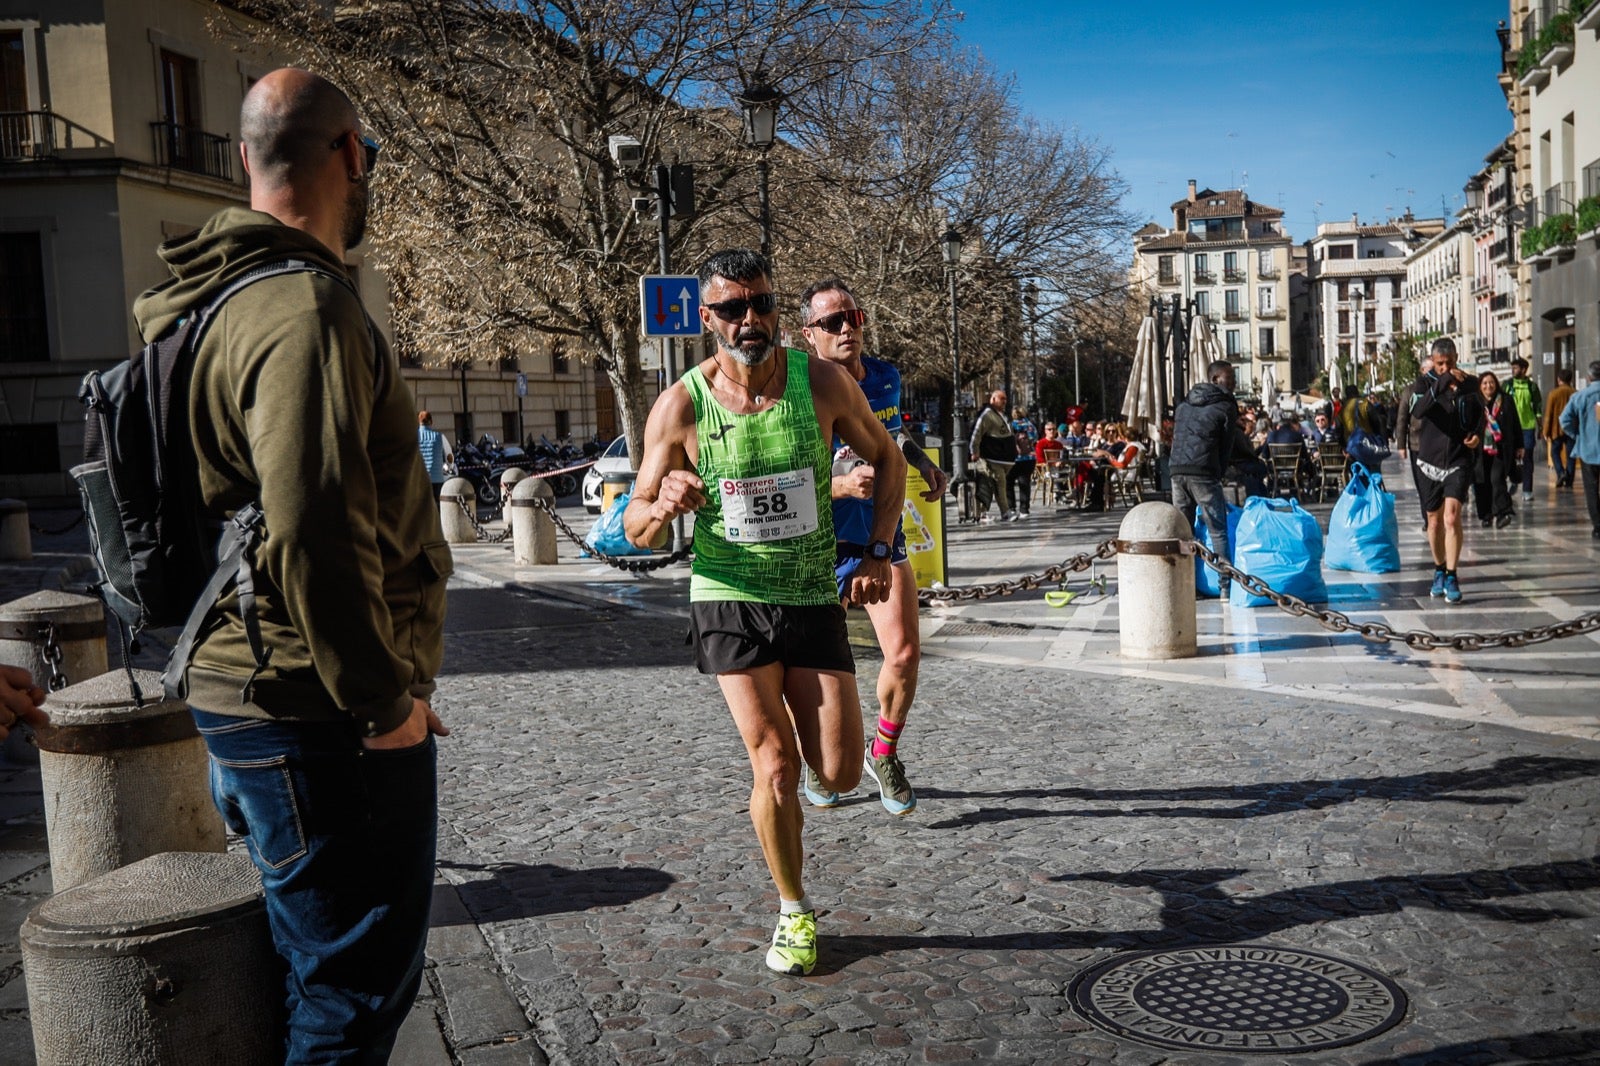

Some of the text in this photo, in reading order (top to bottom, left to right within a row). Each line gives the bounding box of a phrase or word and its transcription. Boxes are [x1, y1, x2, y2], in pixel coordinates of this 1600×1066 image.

[875, 405, 899, 421] mpo
[723, 479, 774, 495] 9 Carrera
[736, 485, 778, 496] Solidaria
[753, 493, 788, 515] 58
[744, 516, 764, 525] FRAN
[1129, 954, 1181, 972] DE
[1178, 949, 1344, 975] NACIONAL
[1130, 1015, 1349, 1047] TELEFONICA
